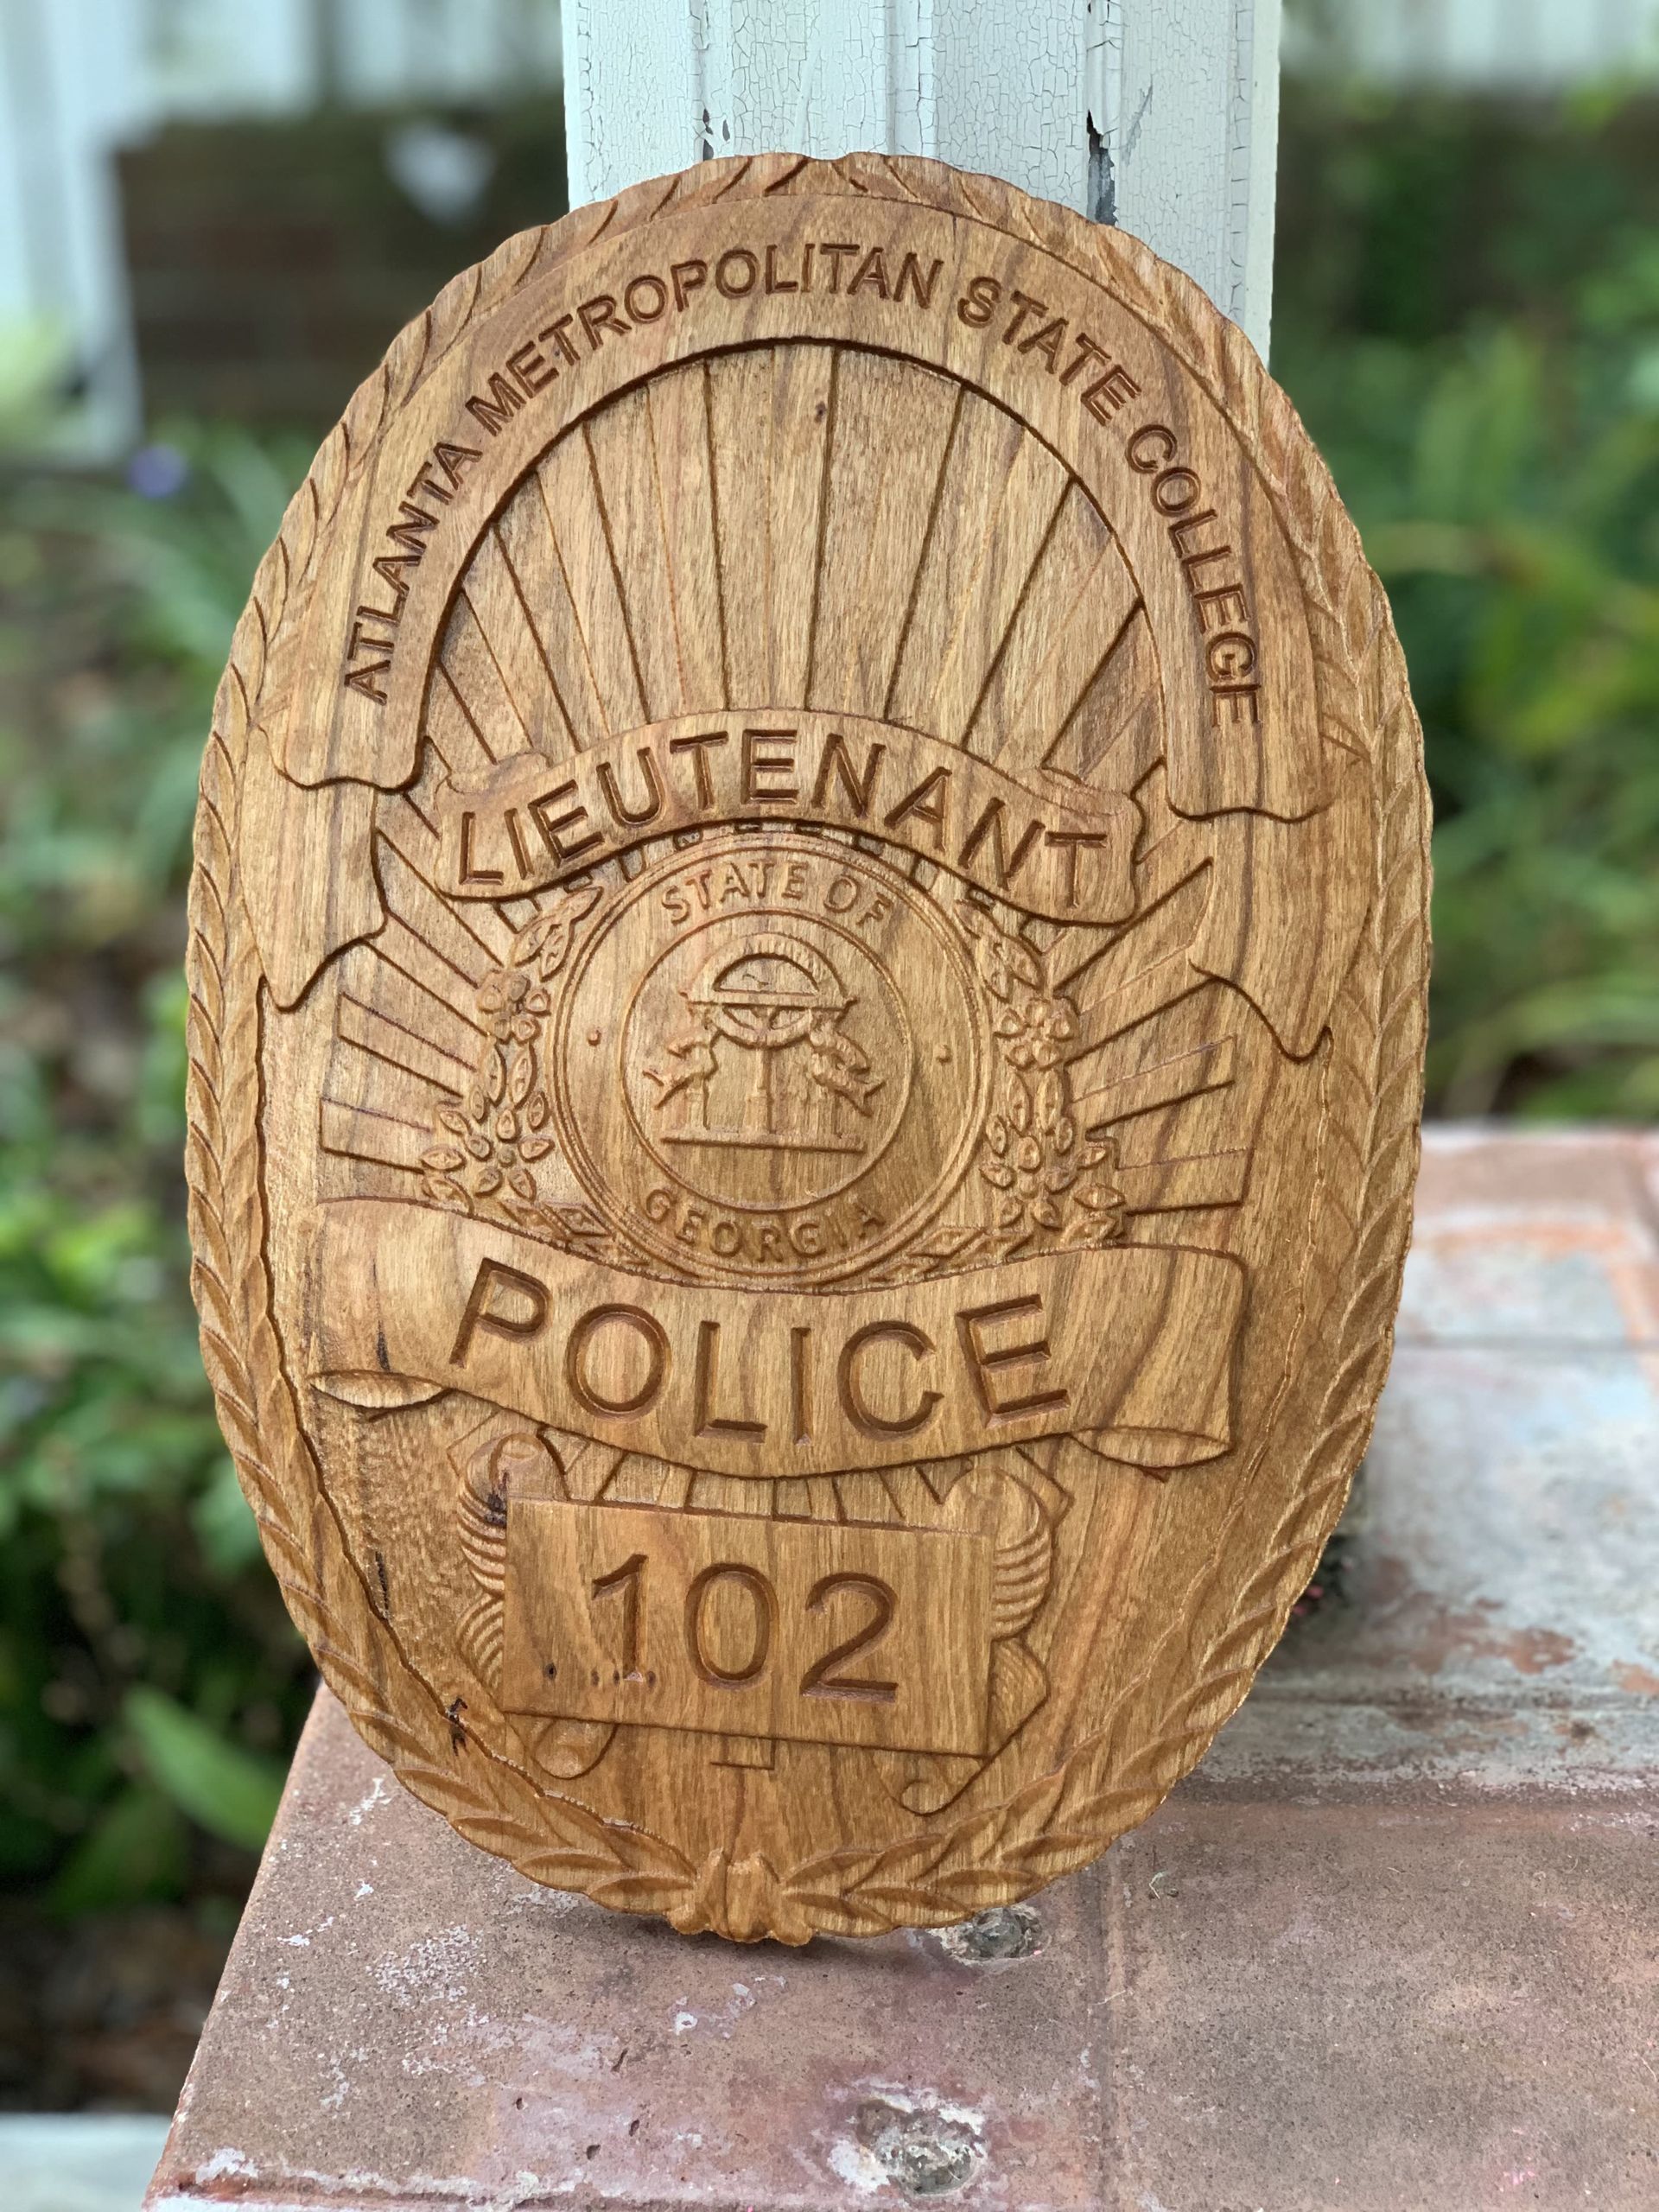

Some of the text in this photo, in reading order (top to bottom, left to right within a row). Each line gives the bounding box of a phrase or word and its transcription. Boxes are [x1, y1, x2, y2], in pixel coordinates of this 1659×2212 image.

[346, 243, 1262, 728] ATLANTA METROPOLITAN STATE COLLEGE
[459, 728, 1107, 908] LIEUTENANT
[661, 861, 894, 930] STATE OF
[645, 1188, 888, 1263] GEORGIA
[448, 1256, 1071, 1446] POLICE
[591, 1553, 899, 1703] 102
